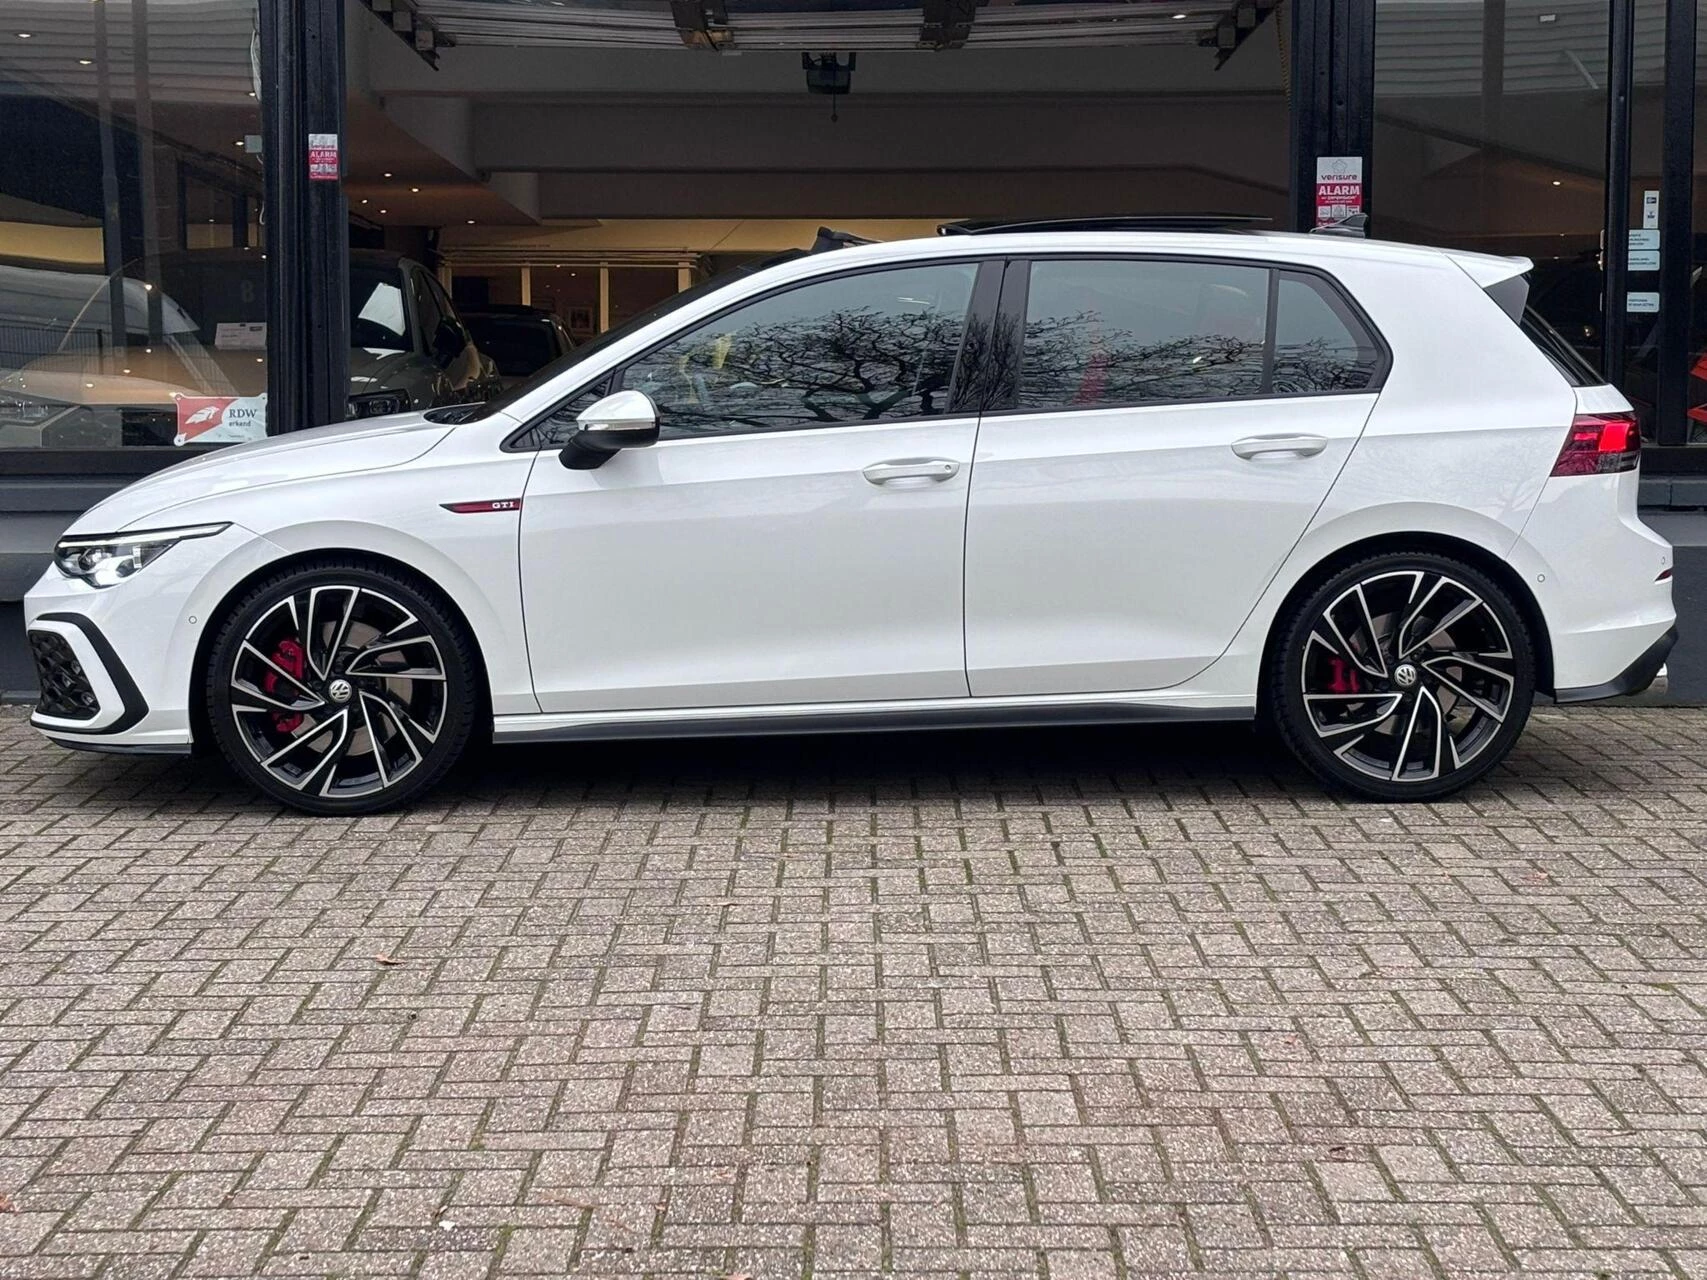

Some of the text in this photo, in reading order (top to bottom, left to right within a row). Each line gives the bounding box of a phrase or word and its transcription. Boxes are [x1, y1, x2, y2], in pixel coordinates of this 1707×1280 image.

[1318, 185, 1360, 195] ALARM
[228, 408, 258, 418] RDW
[492, 501, 515, 509] GTI
